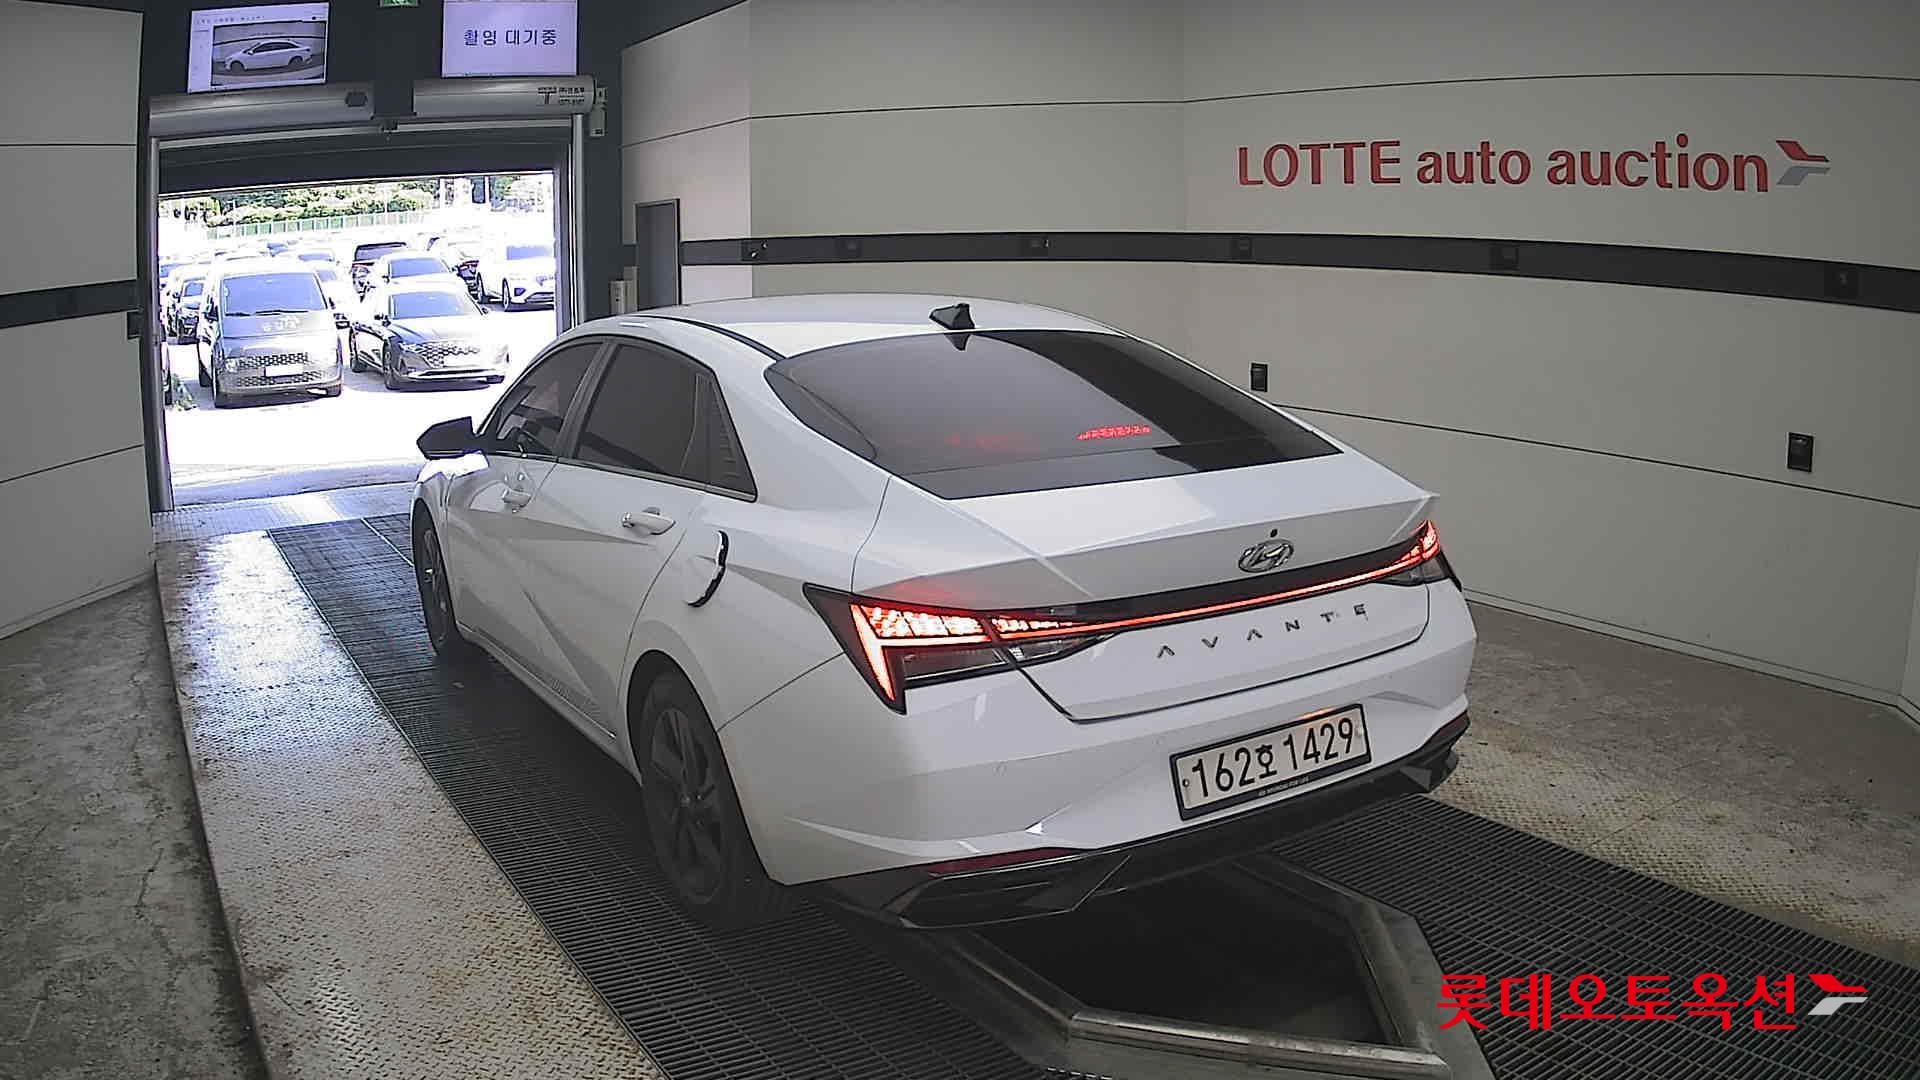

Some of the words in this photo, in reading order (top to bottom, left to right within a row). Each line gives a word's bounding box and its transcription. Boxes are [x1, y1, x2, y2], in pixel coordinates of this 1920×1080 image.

[464, 29, 497, 46] 촬영
[505, 29, 557, 46] 대기중
[1238, 140, 1400, 187] LOTTE
[1417, 141, 1531, 185] auto
[1548, 133, 1769, 192] auction
[1157, 603, 1367, 658] AVANTE
[1192, 744, 1277, 797] 162호
[1283, 718, 1353, 770] 1429
